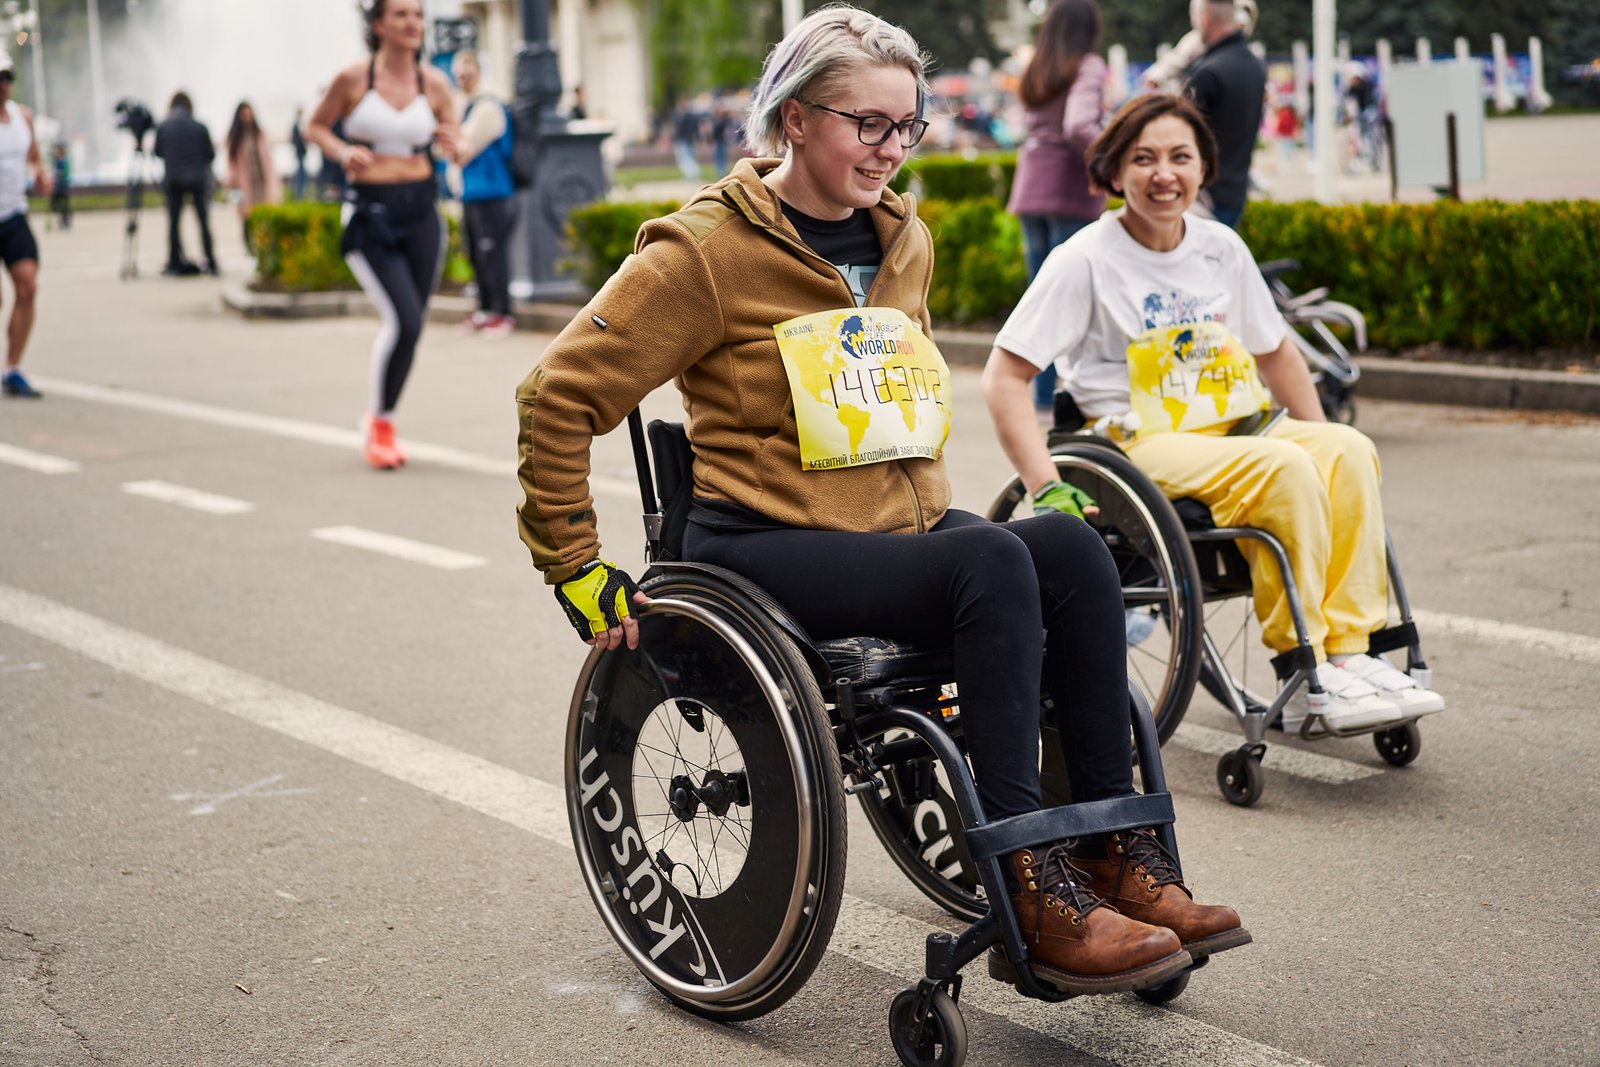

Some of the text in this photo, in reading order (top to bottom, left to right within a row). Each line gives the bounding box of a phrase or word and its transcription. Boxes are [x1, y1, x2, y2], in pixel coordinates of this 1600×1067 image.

[783, 323, 814, 338] UKRAINE
[828, 365, 944, 410] 148302
[850, 446, 899, 465] БЛАГОДІЙНИЙ
